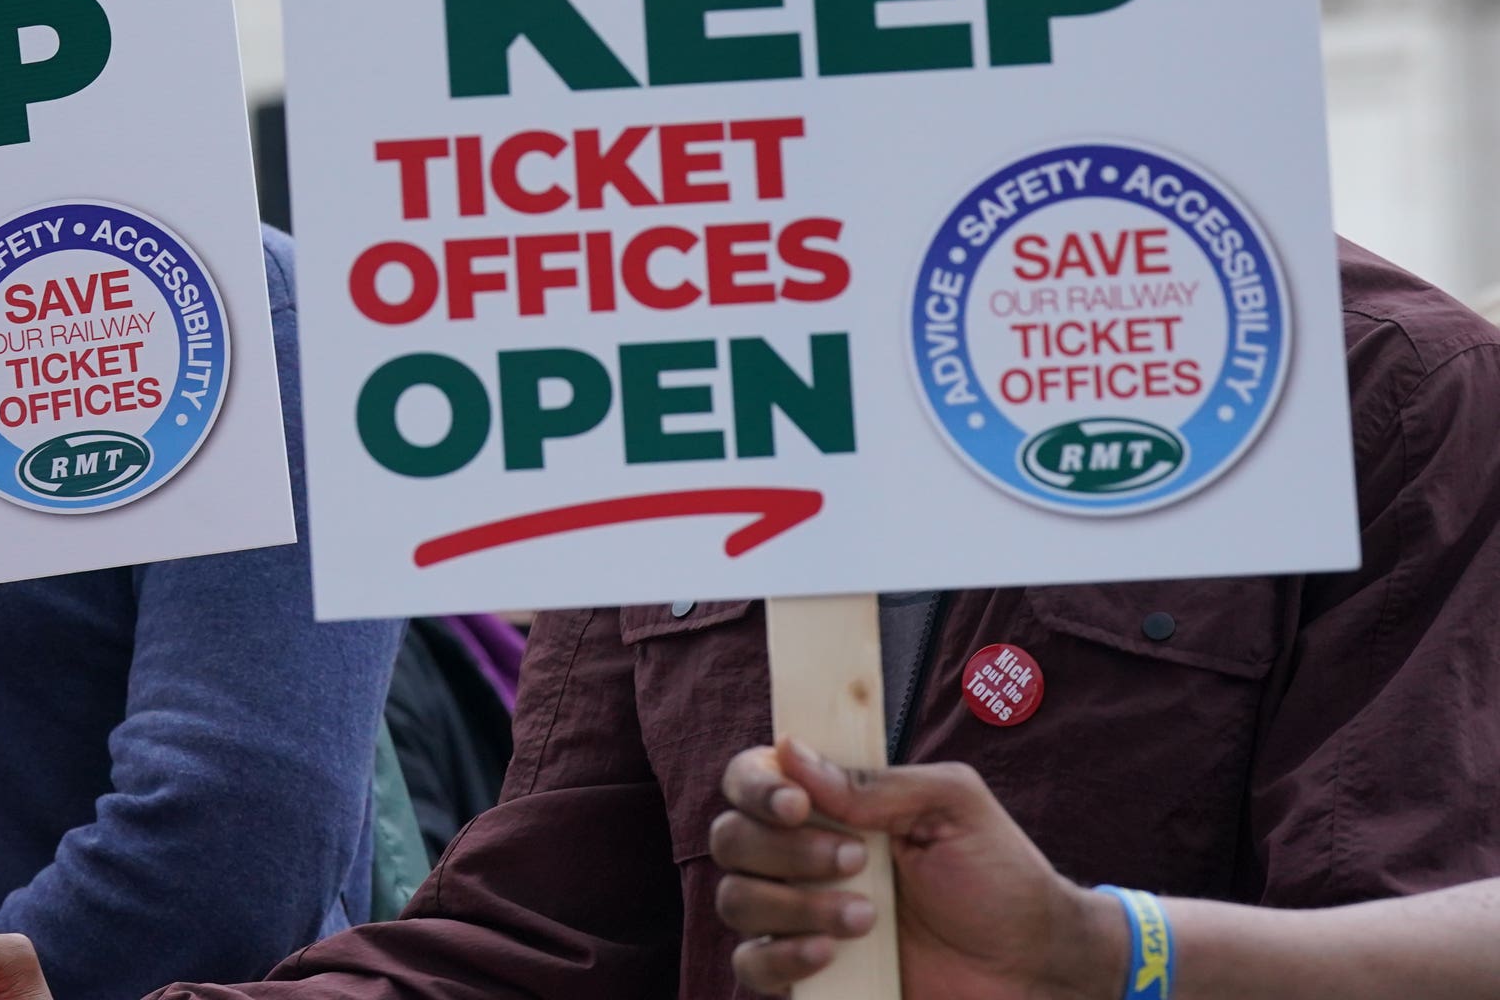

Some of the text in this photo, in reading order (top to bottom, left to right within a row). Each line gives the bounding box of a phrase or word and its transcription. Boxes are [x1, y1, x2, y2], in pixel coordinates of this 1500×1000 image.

[375, 118, 804, 220] TICKET
[349, 218, 850, 325] OFFICES
[1013, 228, 1171, 281] SAVE
[5, 269, 133, 323] SAVE
[925, 158, 1268, 405] ADVICE SAFETY ACCESSIBILITY
[989, 281, 1199, 318] OUR RAILWAY
[51, 312, 155, 345] RAILWAY
[91, 219, 212, 410] ACCESSIBILITY
[1011, 316, 1181, 358] TICKET
[5, 342, 144, 388] TICKET
[1000, 360, 1203, 404] OFFICES
[0, 377, 162, 427] OFFICES
[357, 333, 855, 477] OPEN
[50, 448, 123, 479] RMT
[1060, 441, 1151, 472] RMT
[982, 664, 1023, 704] out the
[994, 648, 1034, 688] Kick
[966, 671, 1013, 722] Tories
